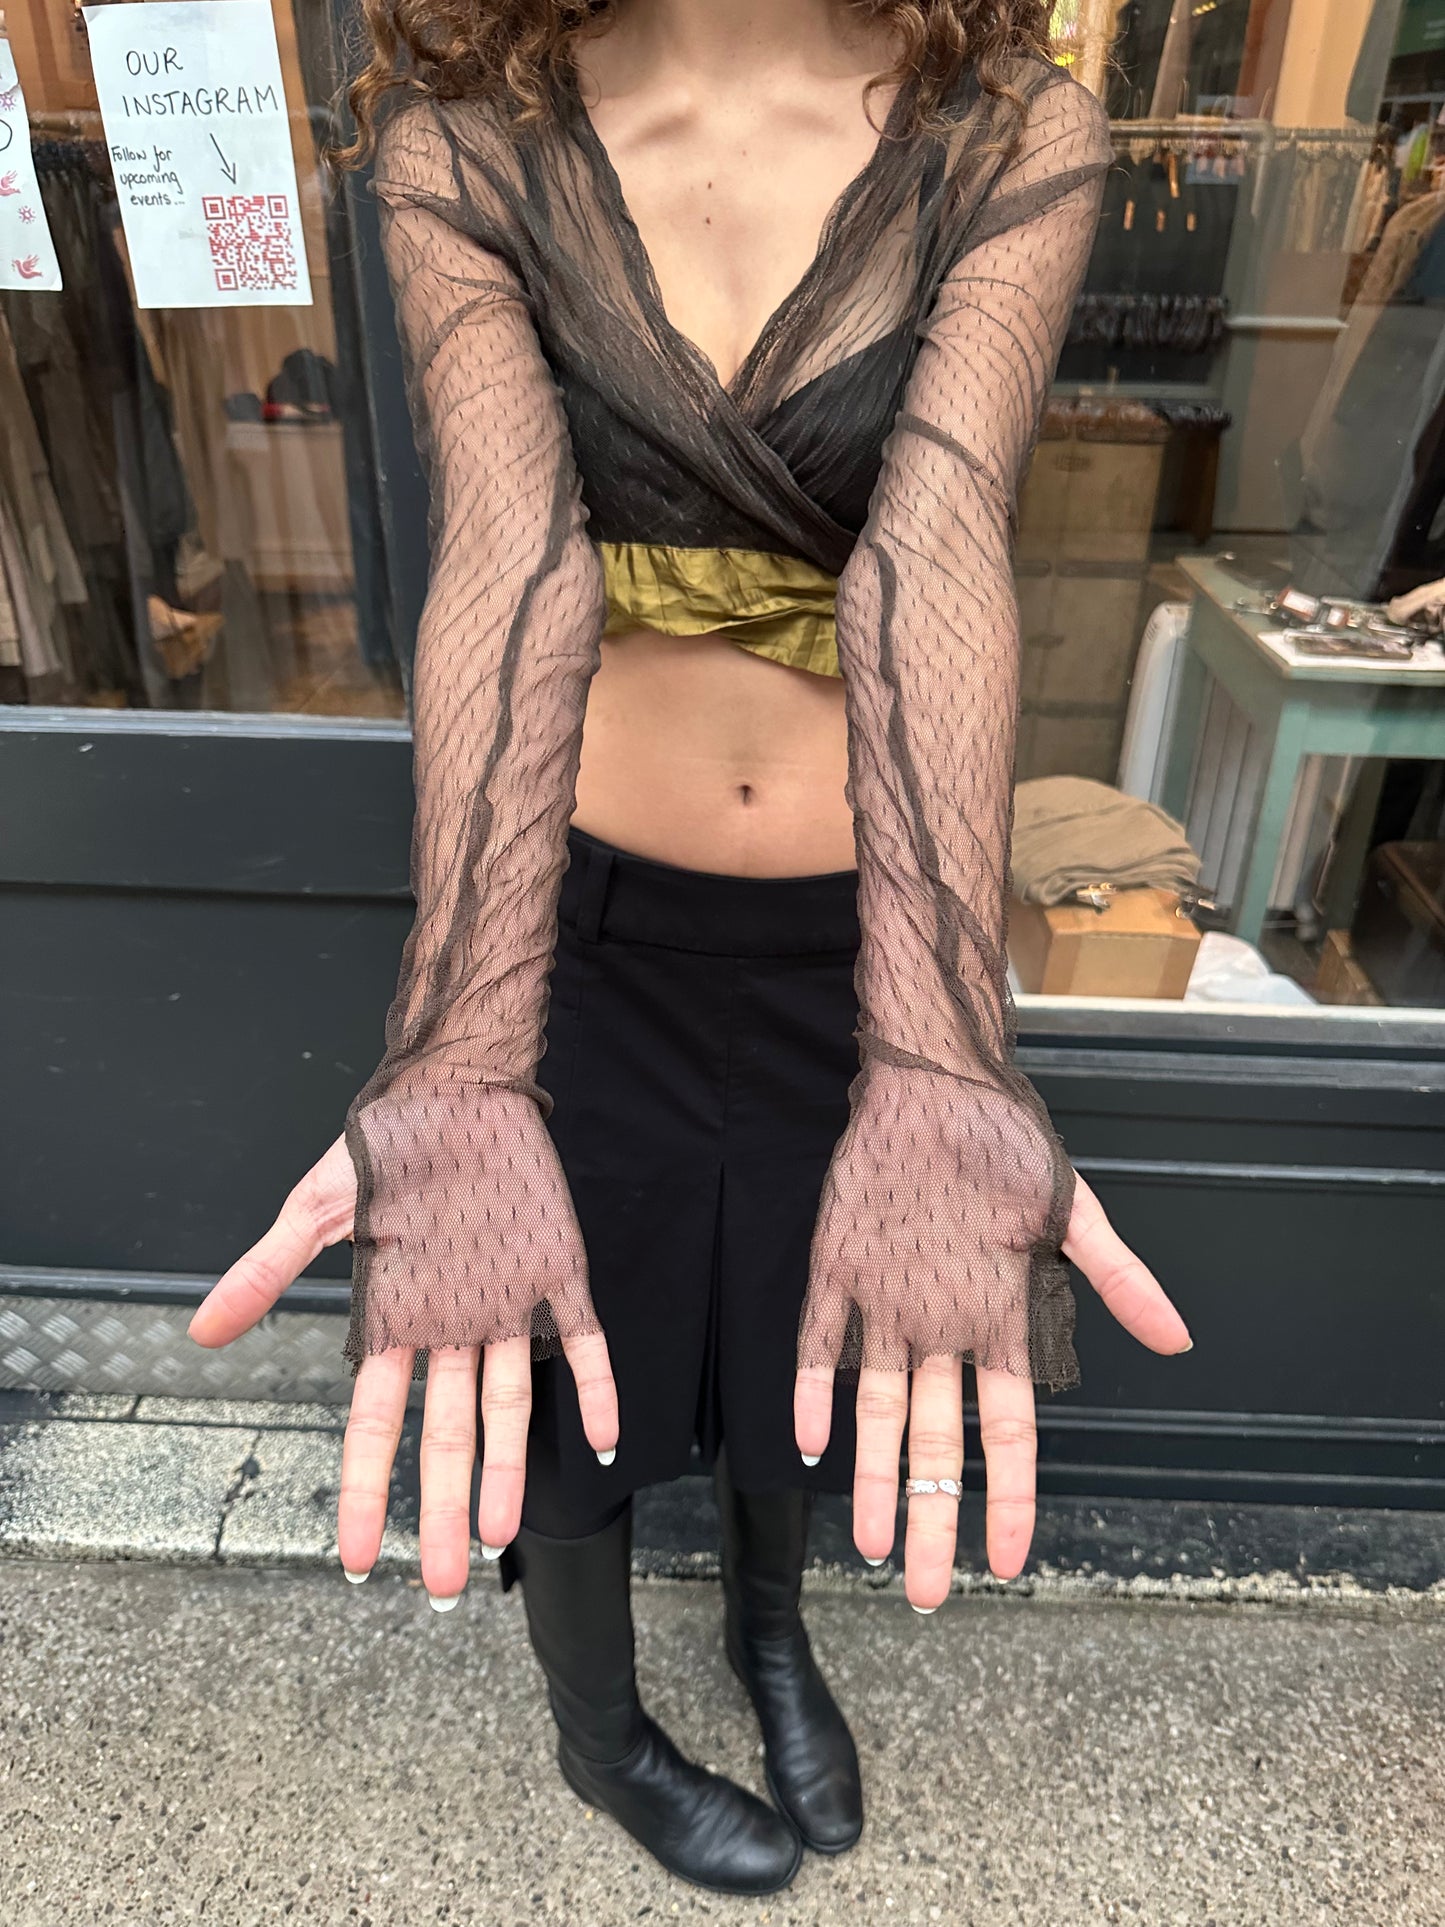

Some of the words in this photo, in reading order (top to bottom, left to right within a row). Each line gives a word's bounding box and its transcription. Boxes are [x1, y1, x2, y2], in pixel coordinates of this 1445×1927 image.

[126, 47, 184, 76] OUR
[122, 84, 279, 117] INSTAGRAM
[111, 145, 147, 162] Follow
[153, 145, 173, 173] for
[119, 171, 184, 195] upcoming
